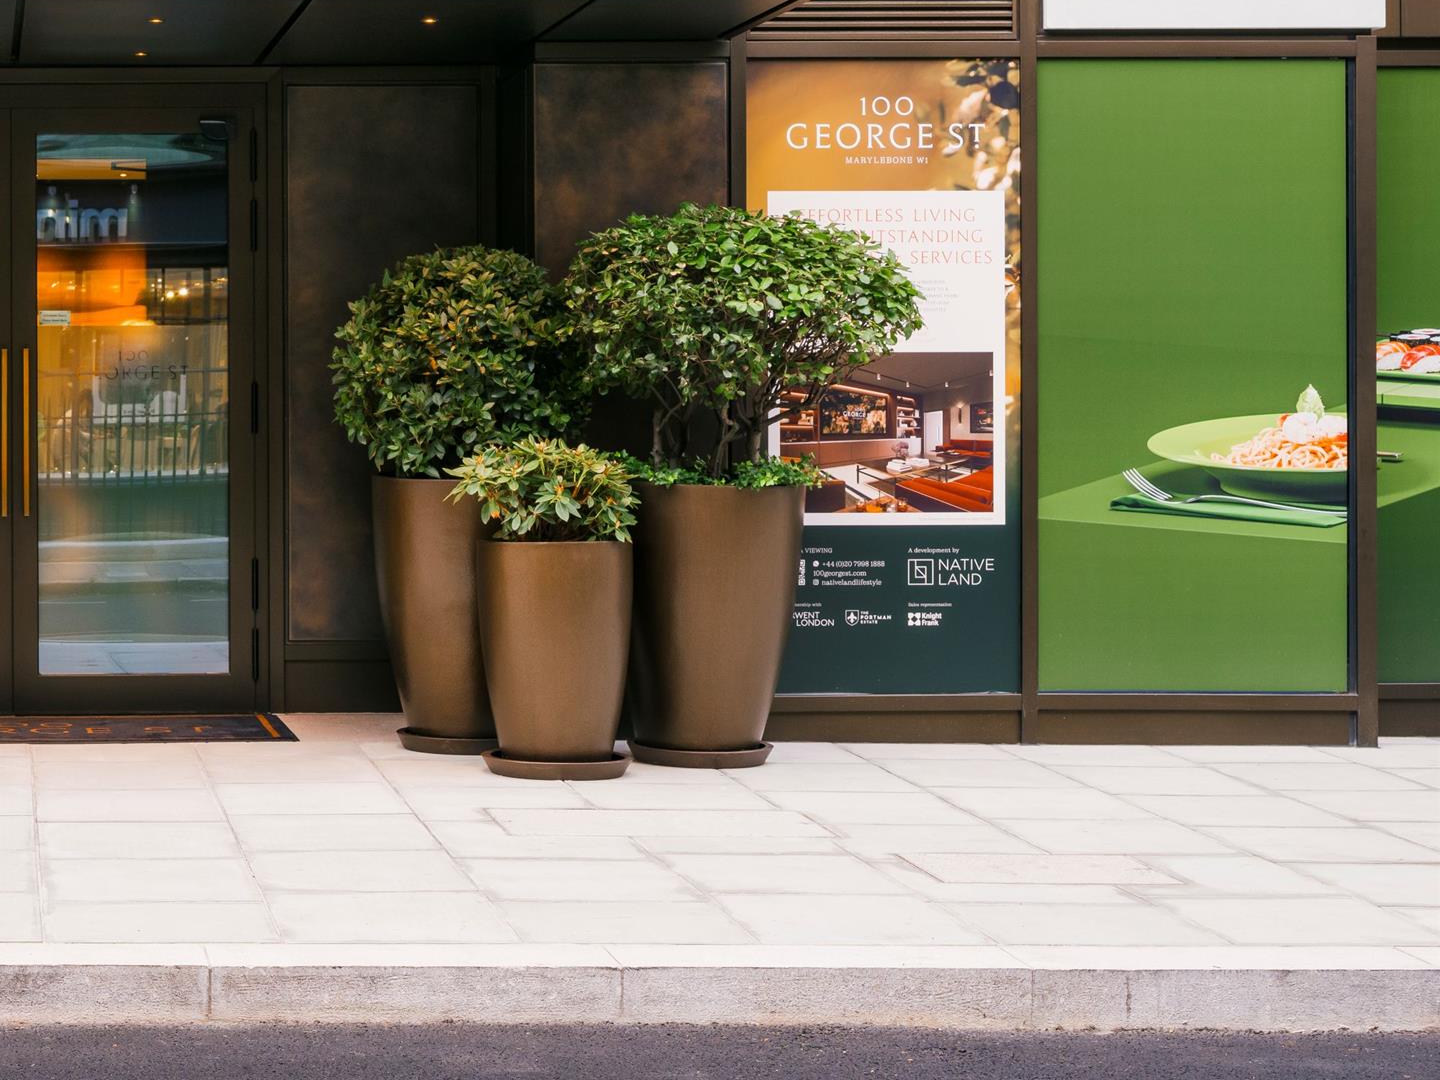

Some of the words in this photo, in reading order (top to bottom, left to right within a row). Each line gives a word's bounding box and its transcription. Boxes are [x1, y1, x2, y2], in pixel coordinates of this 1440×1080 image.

[859, 96, 914, 116] 100
[786, 123, 934, 150] GEORGE
[845, 156, 913, 165] MARYLEBONE
[916, 156, 929, 165] W1
[914, 208, 976, 223] LIVING
[911, 250, 993, 265] SERVICES
[835, 560, 853, 568] (0)20
[939, 559, 995, 571] NATIVE
[813, 569, 867, 578] 100georgest.com
[821, 578, 883, 587] nativelandlifestyle
[939, 573, 982, 586] LAND
[922, 612, 942, 620] Knight
[796, 619, 835, 627] LONDON
